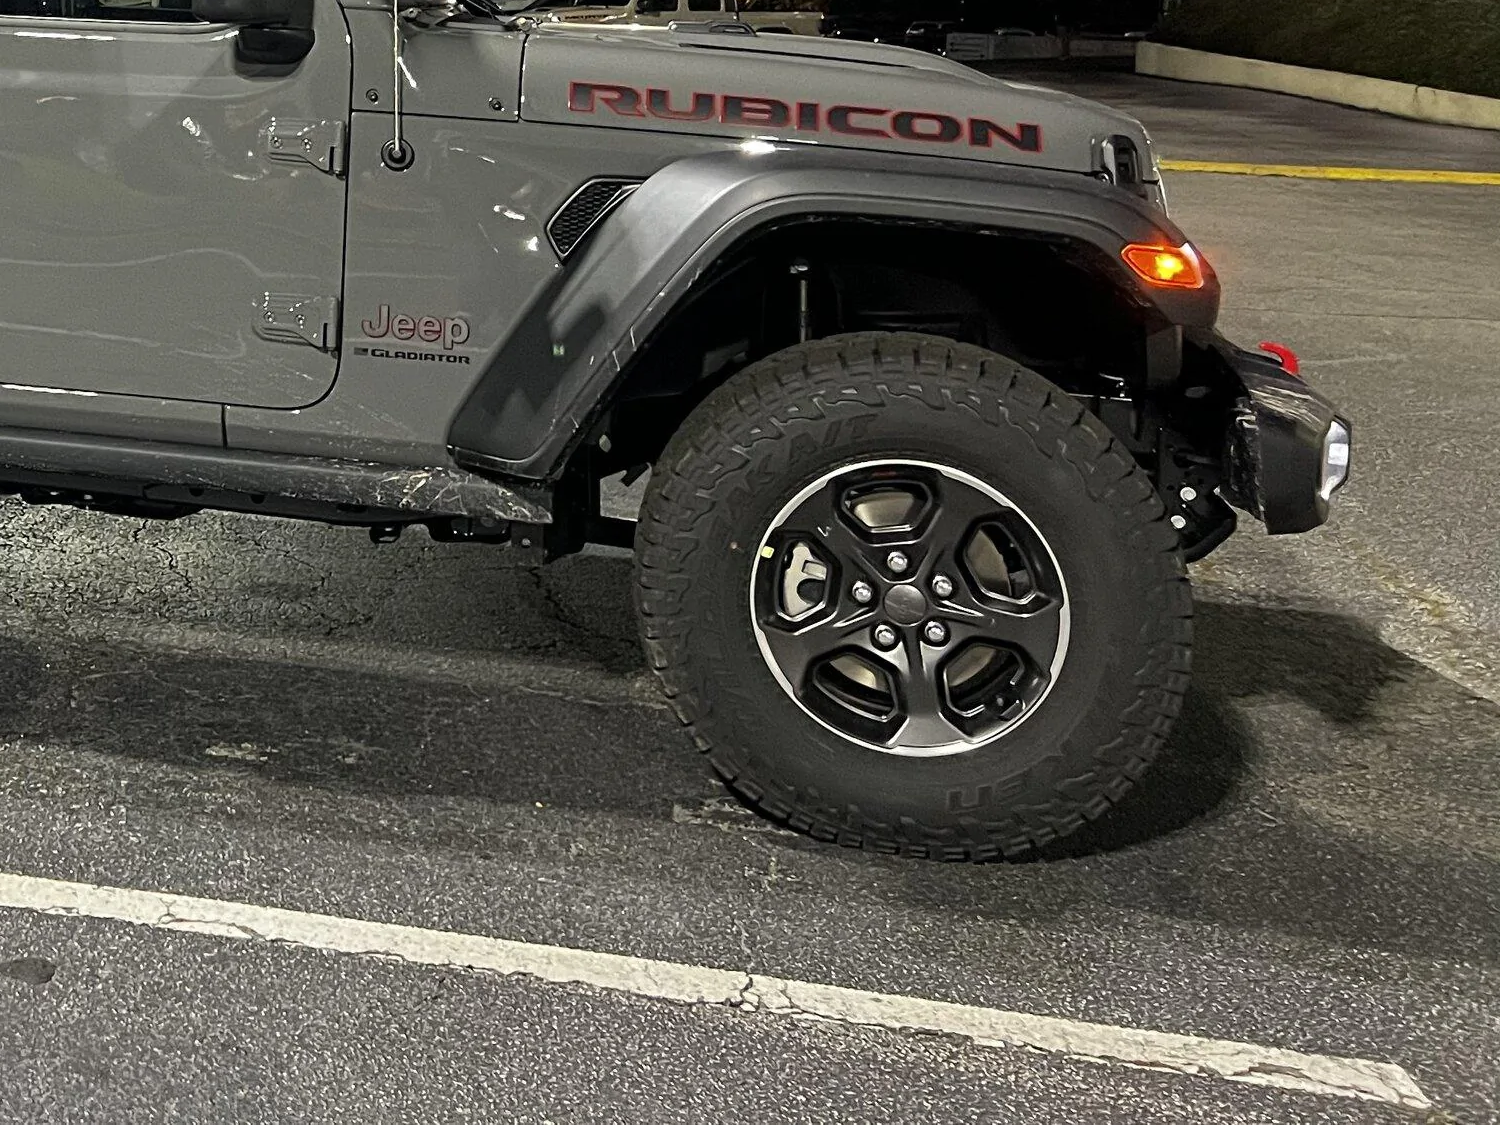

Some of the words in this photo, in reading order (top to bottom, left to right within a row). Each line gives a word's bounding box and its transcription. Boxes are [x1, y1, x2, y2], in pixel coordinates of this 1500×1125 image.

[567, 80, 1045, 154] RUBICON
[361, 304, 469, 350] Jeep
[371, 349, 470, 364] GLADIATOR
